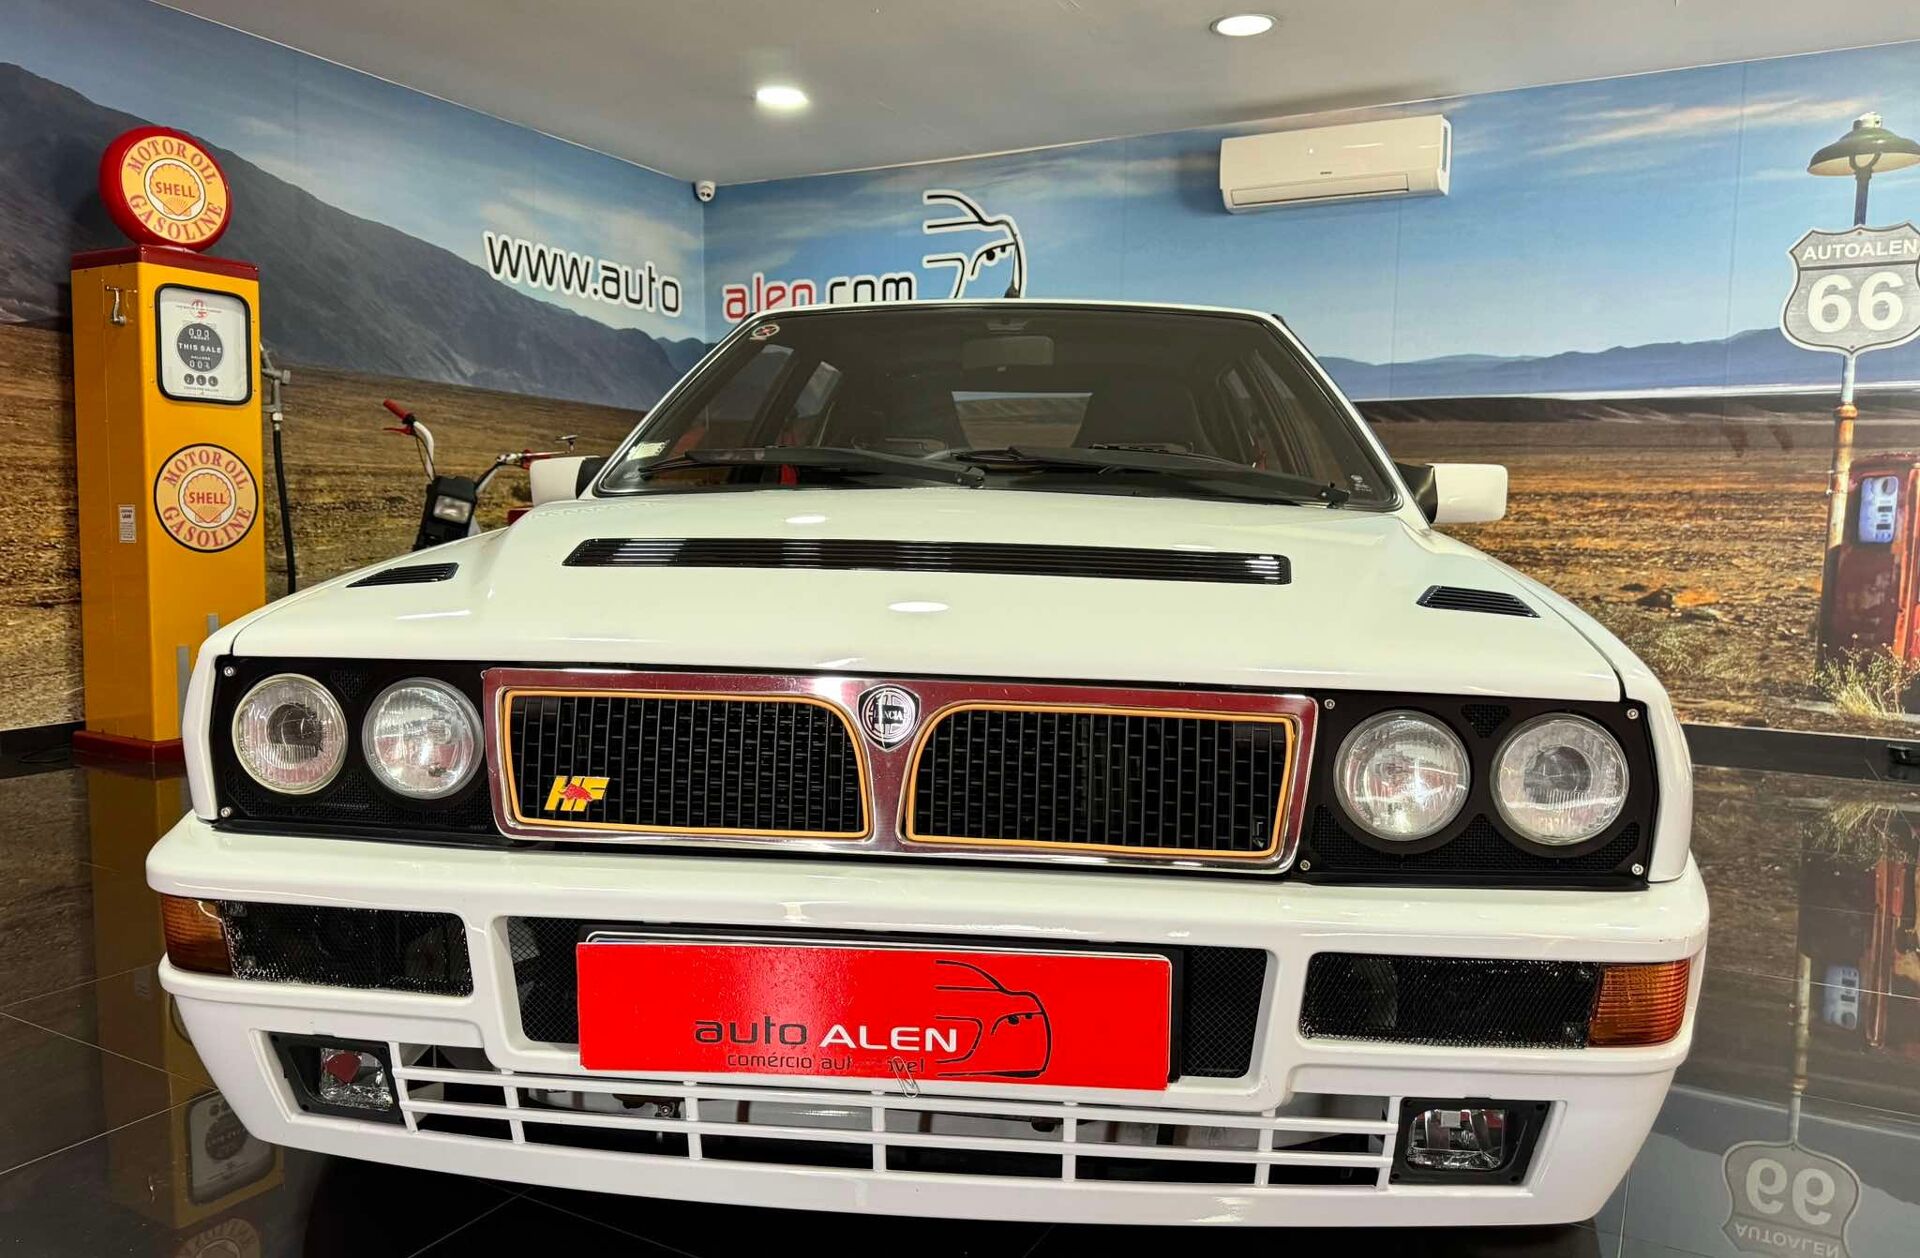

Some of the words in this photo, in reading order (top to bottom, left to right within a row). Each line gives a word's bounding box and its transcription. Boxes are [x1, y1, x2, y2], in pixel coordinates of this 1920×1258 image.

[127, 139, 188, 176] MOTOR
[190, 153, 217, 185] OIL
[155, 181, 196, 198] SHELL
[129, 194, 223, 241] GASOLINE
[1802, 238, 1918, 261] AUTOALEN
[486, 234, 680, 314] www.auto
[1807, 271, 1905, 333] 66
[178, 342, 198, 351] THIS
[200, 345, 222, 354] SALE
[163, 449, 222, 487] MOTOR
[224, 460, 249, 490] OIL
[189, 491, 226, 505] SHELL
[163, 506, 251, 543] GASOLINE
[544, 776, 610, 812] HF
[695, 1015, 807, 1046] auto
[819, 1024, 957, 1053] ALEN
[727, 1052, 813, 1070] comércio
